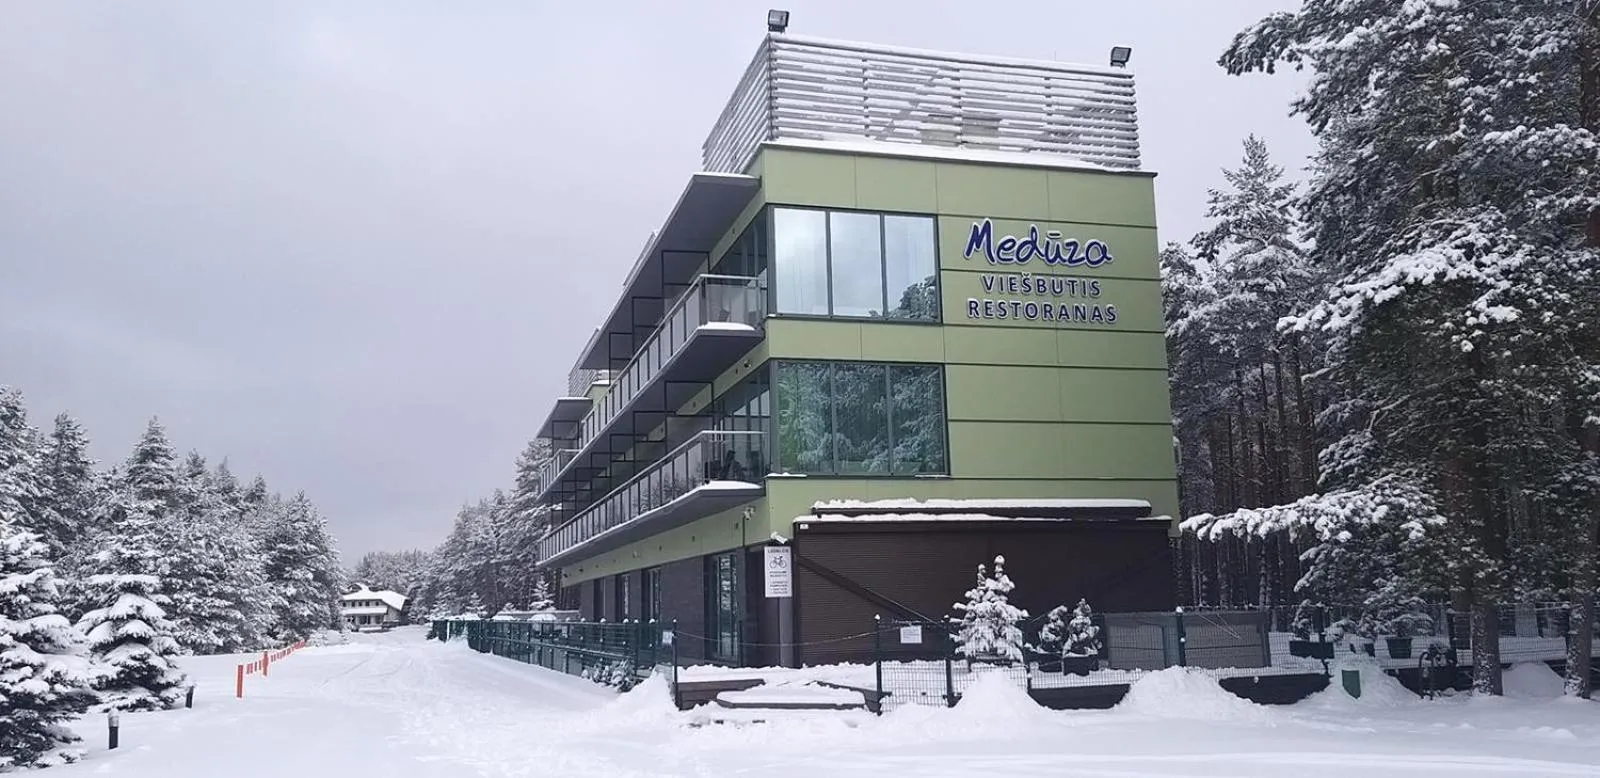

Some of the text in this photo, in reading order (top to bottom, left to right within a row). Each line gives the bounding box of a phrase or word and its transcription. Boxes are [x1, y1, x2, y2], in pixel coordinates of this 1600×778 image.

[964, 218, 1112, 267] Medūza
[982, 272, 1102, 298] VIEŠBUTIS
[967, 298, 1118, 324] RESTORANAS
